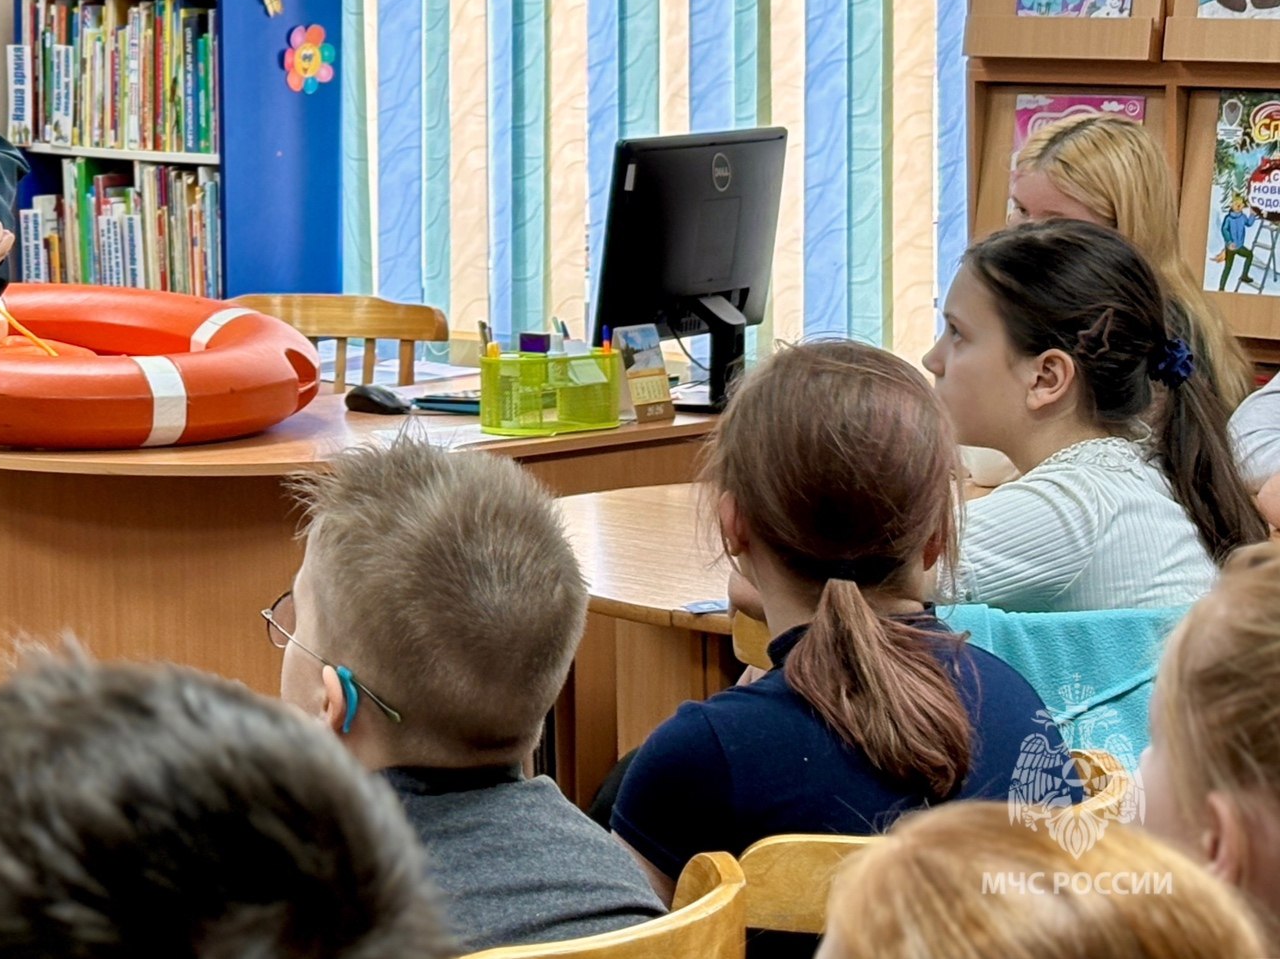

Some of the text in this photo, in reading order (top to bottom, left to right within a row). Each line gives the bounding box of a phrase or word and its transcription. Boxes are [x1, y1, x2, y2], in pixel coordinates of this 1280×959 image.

[12, 47, 26, 121] Наша армия
[1251, 196, 1280, 208] ГОДО
